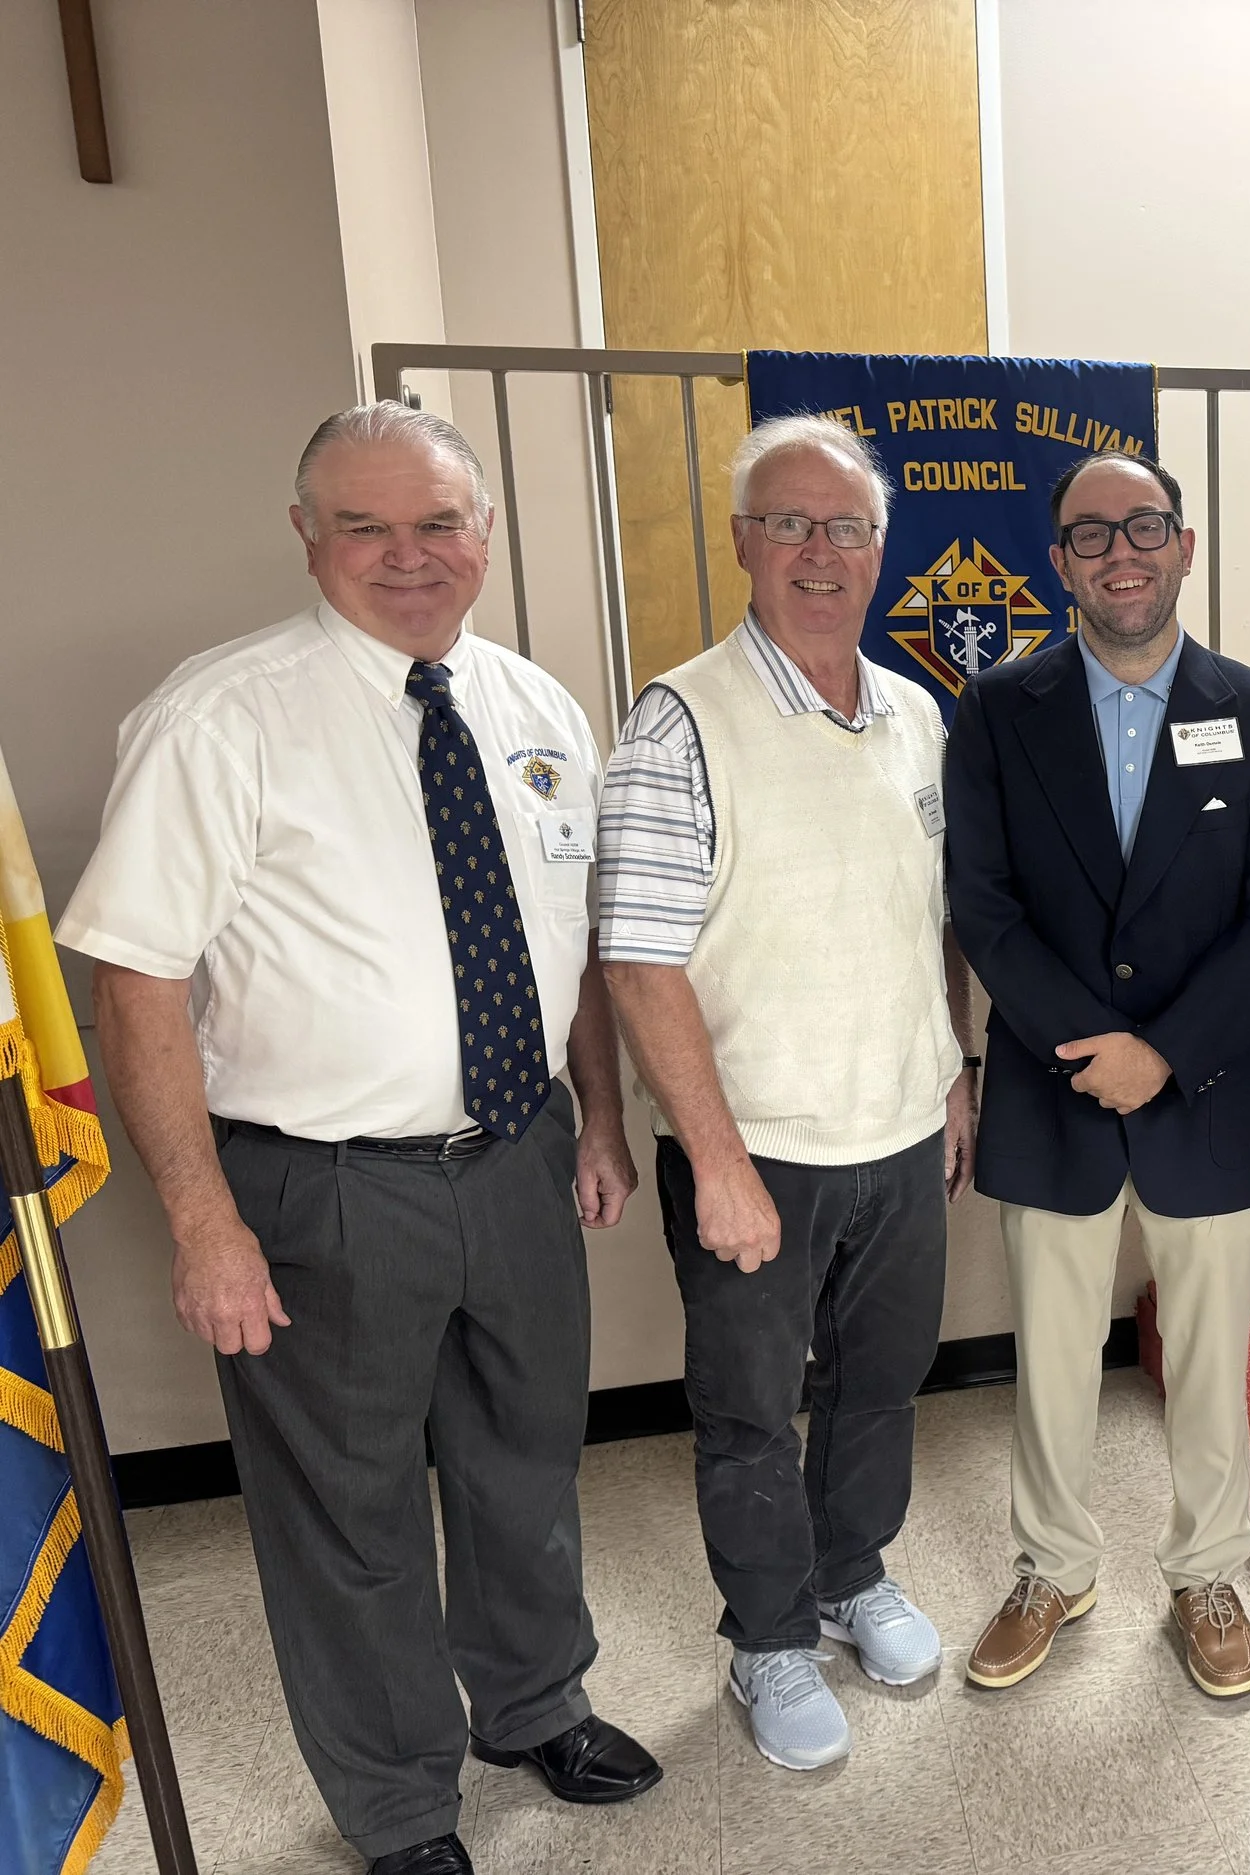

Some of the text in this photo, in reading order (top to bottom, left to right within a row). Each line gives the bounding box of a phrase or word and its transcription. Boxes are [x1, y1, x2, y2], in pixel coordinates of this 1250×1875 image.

[887, 398, 998, 433] PATRICK
[1015, 401, 1144, 456] SULLIVAN
[903, 461, 1026, 491] COUNCIL
[931, 579, 1007, 602] K OF C
[1190, 724, 1233, 733] KNIGHTS
[1200, 729, 1235, 737] COLUMBUS
[506, 748, 568, 766] KNIGHTS OF COLUMBUS
[550, 852, 565, 861] Randy
